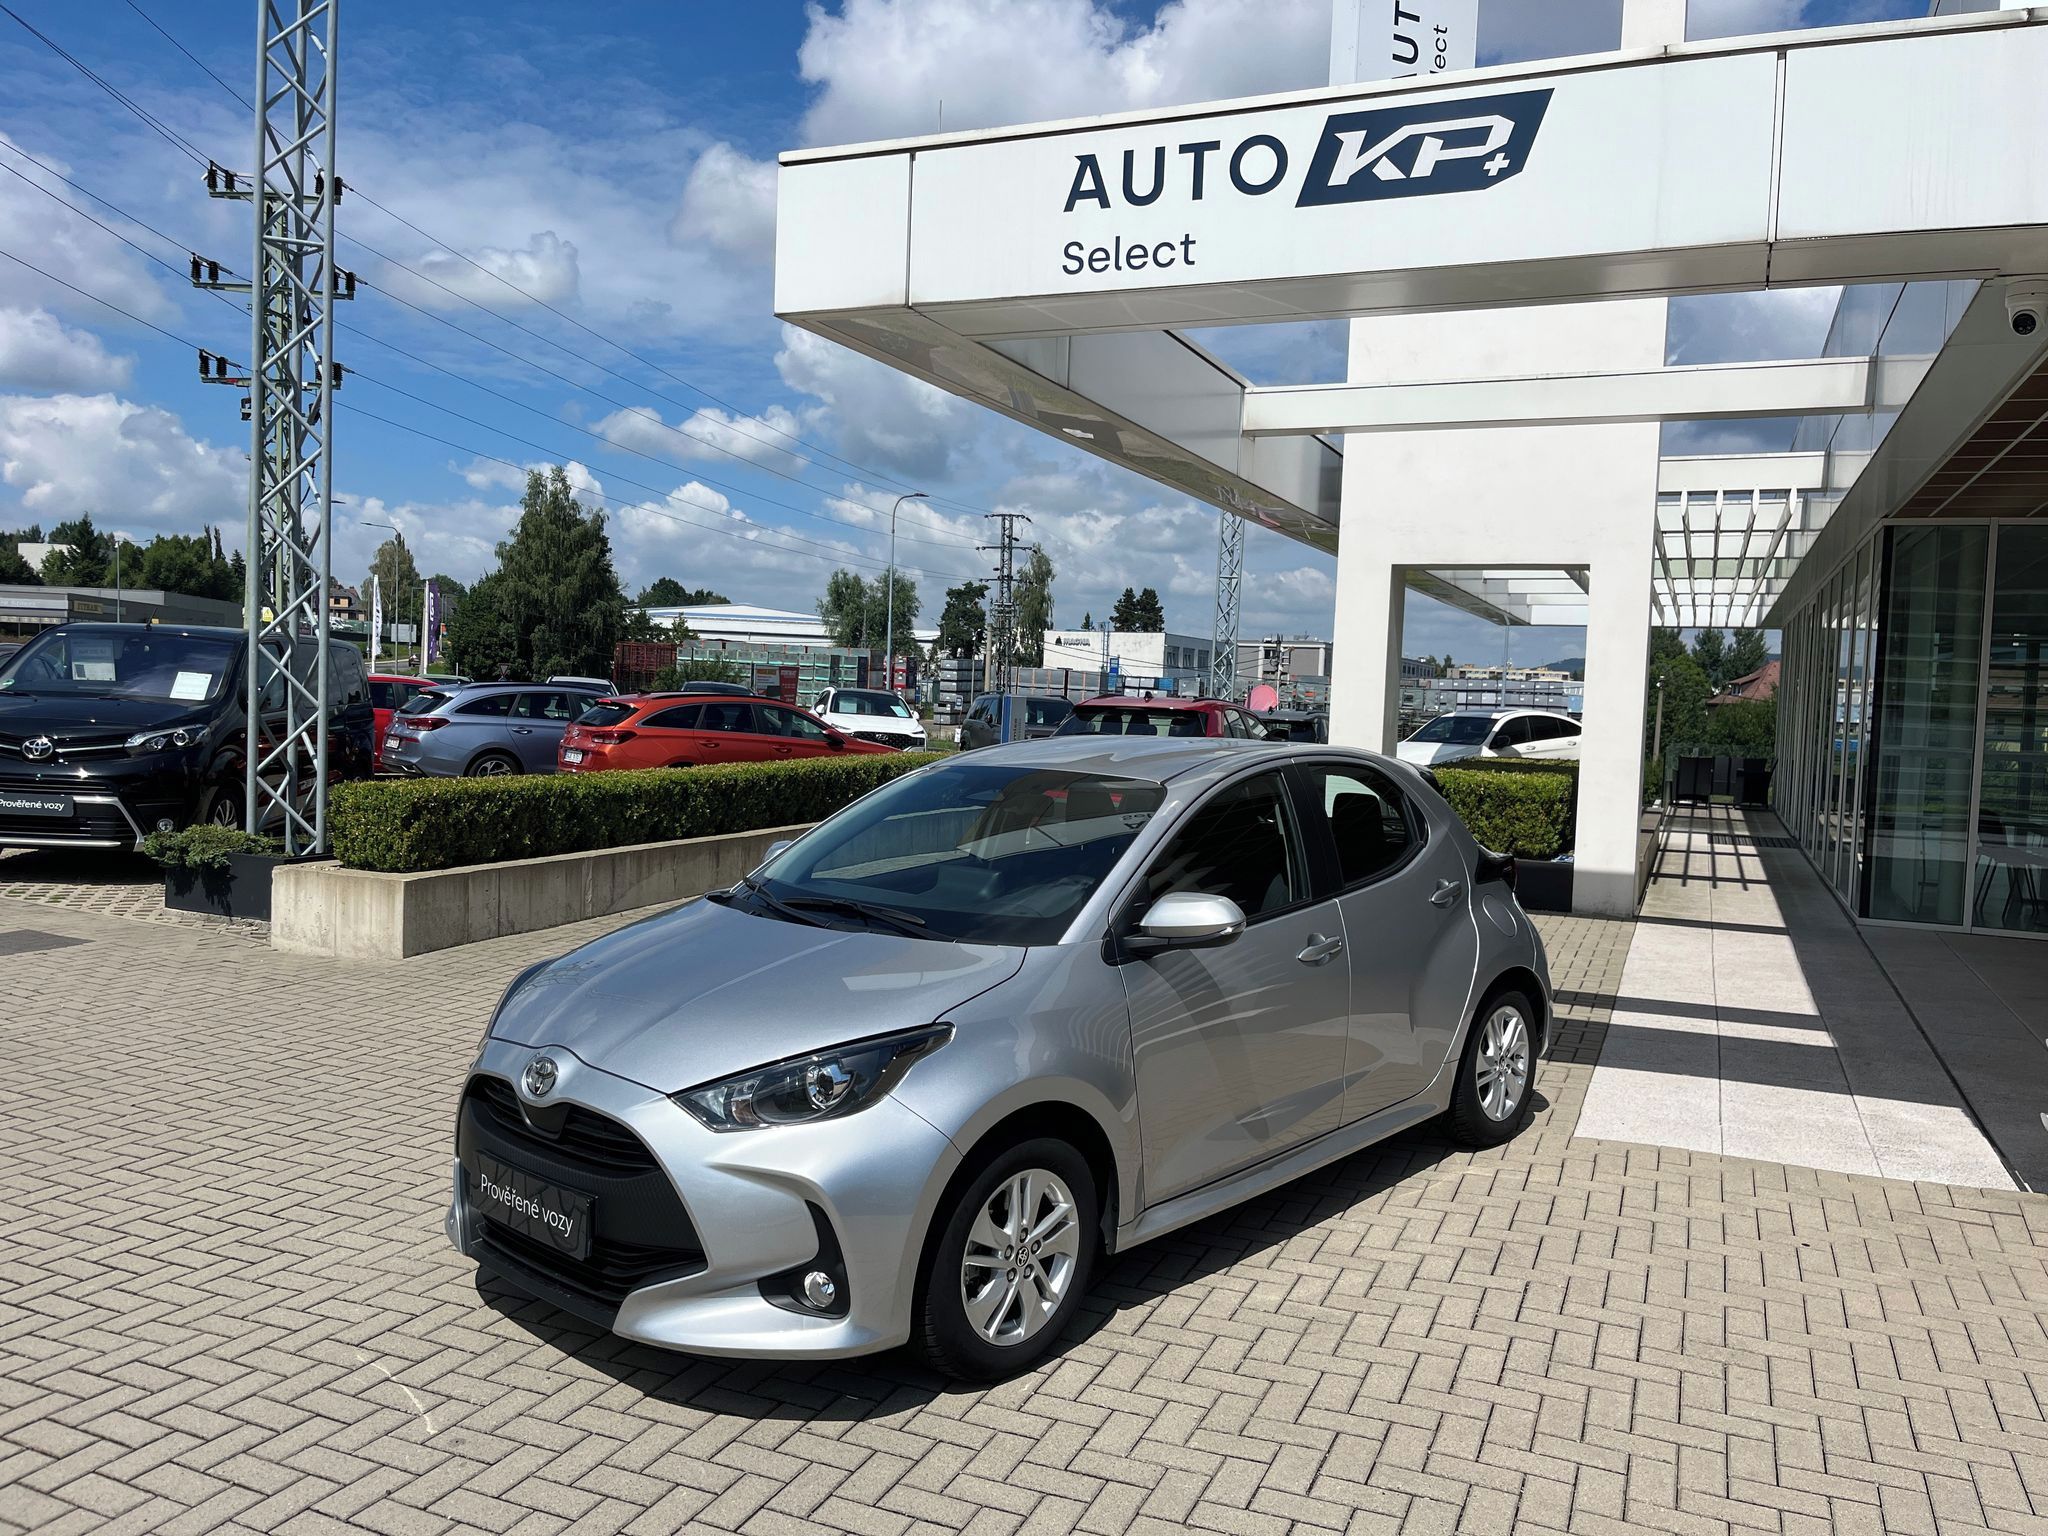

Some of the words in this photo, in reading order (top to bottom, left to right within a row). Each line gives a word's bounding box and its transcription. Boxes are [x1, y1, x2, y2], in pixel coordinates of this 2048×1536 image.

[1392, 0, 1420, 79] UT
[1063, 134, 1289, 213] AUTO
[1062, 233, 1197, 275] Select
[44, 802, 65, 812] vozy
[481, 1173, 540, 1219] Prověřené
[542, 1207, 574, 1237] vozy
